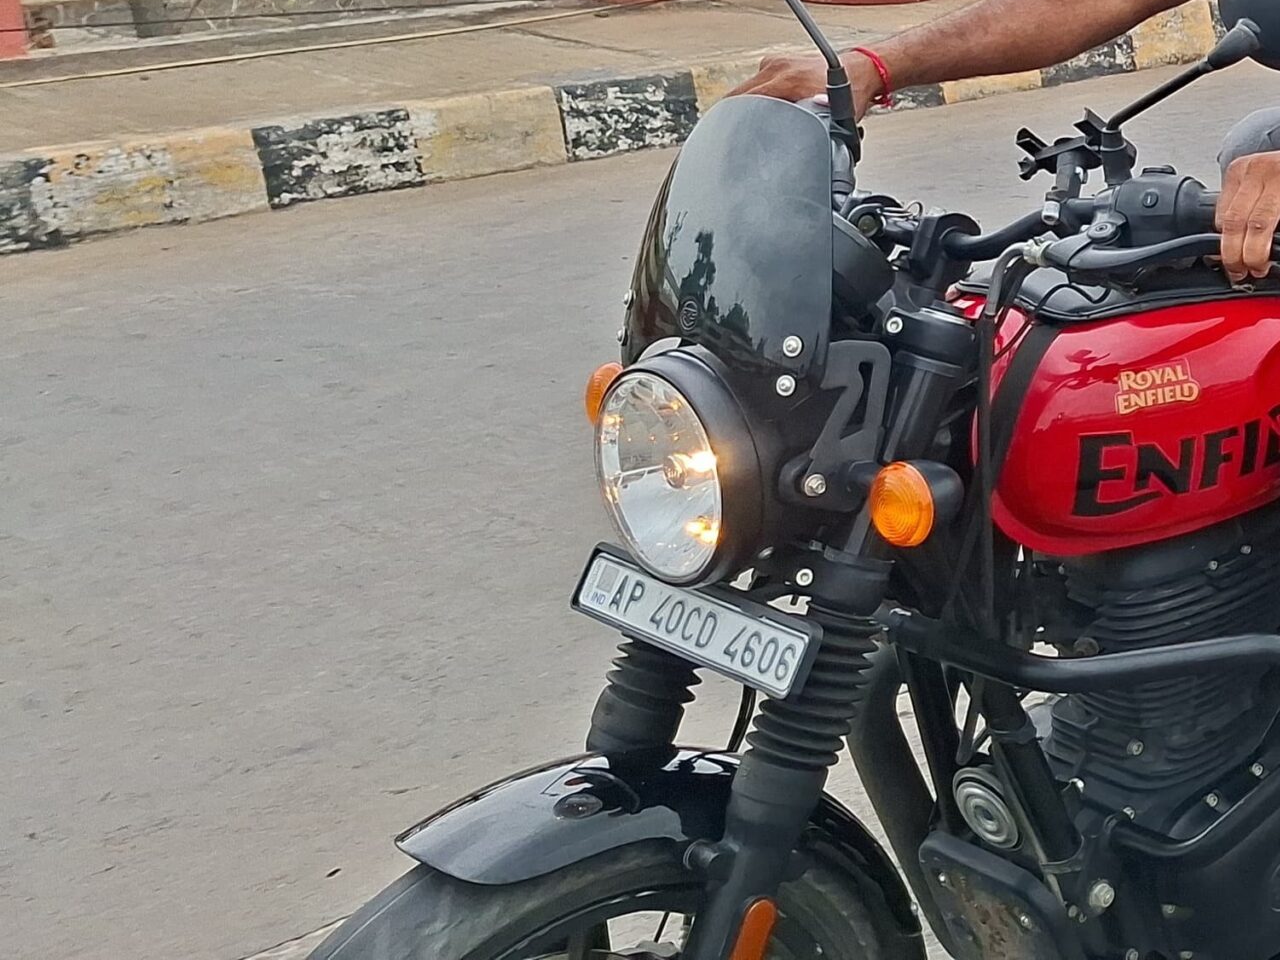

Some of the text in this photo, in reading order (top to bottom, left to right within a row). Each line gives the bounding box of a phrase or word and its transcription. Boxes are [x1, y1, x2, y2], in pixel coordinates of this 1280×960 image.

[1120, 364, 1188, 391] ROYAL
[1117, 383, 1199, 415] ENFIELD
[591, 591, 606, 605] IND
[609, 575, 797, 681] AP 40CD 4606
